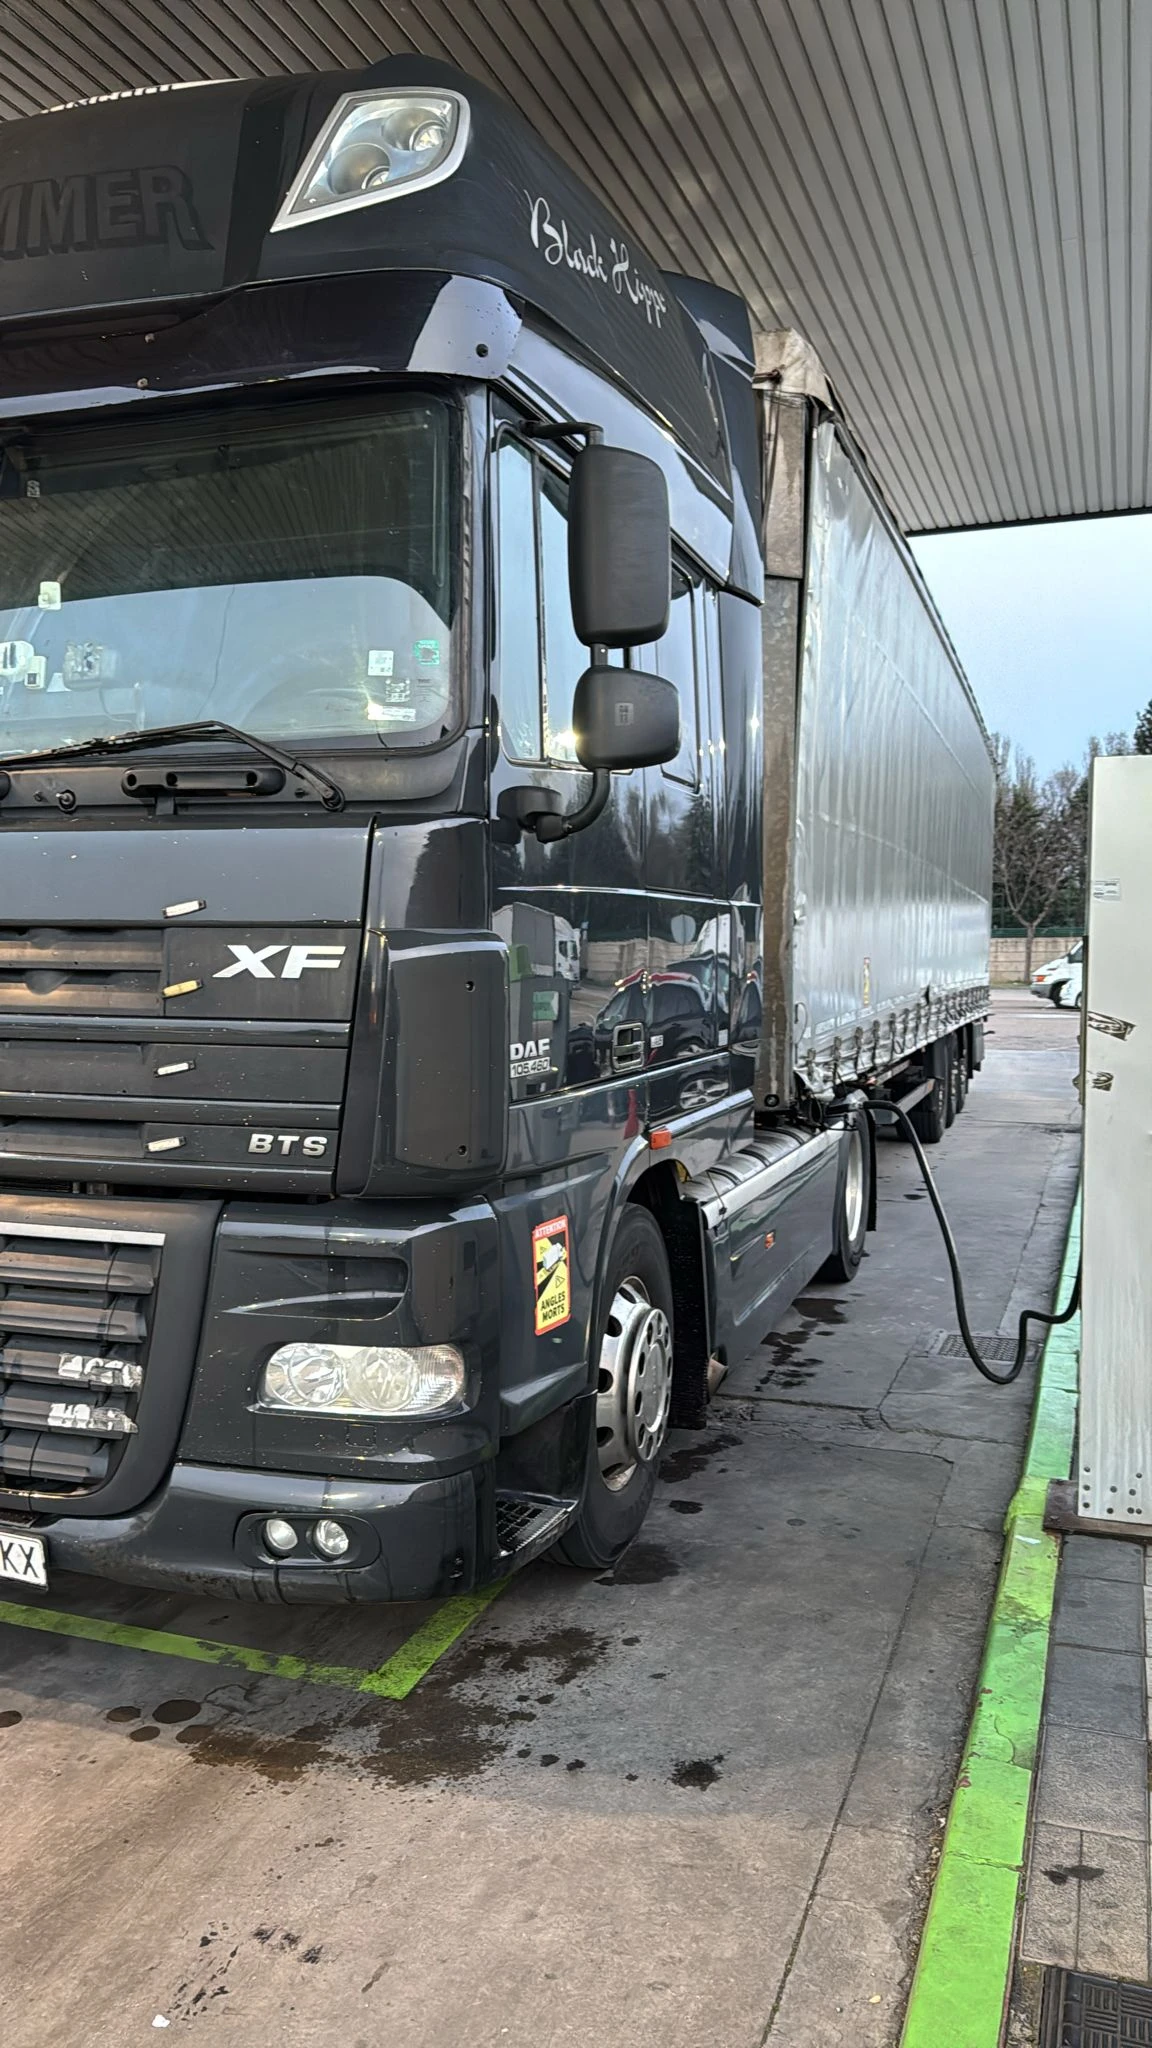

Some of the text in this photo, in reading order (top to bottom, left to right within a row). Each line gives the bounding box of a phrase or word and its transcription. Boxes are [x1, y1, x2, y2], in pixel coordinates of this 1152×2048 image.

[523, 189, 607, 265] Black
[211, 944, 346, 979] XF
[510, 1038, 550, 1060] DAF
[248, 1133, 328, 1157] BTS
[541, 1291, 565, 1311] ANGLES
[542, 1304, 565, 1322] MORTS
